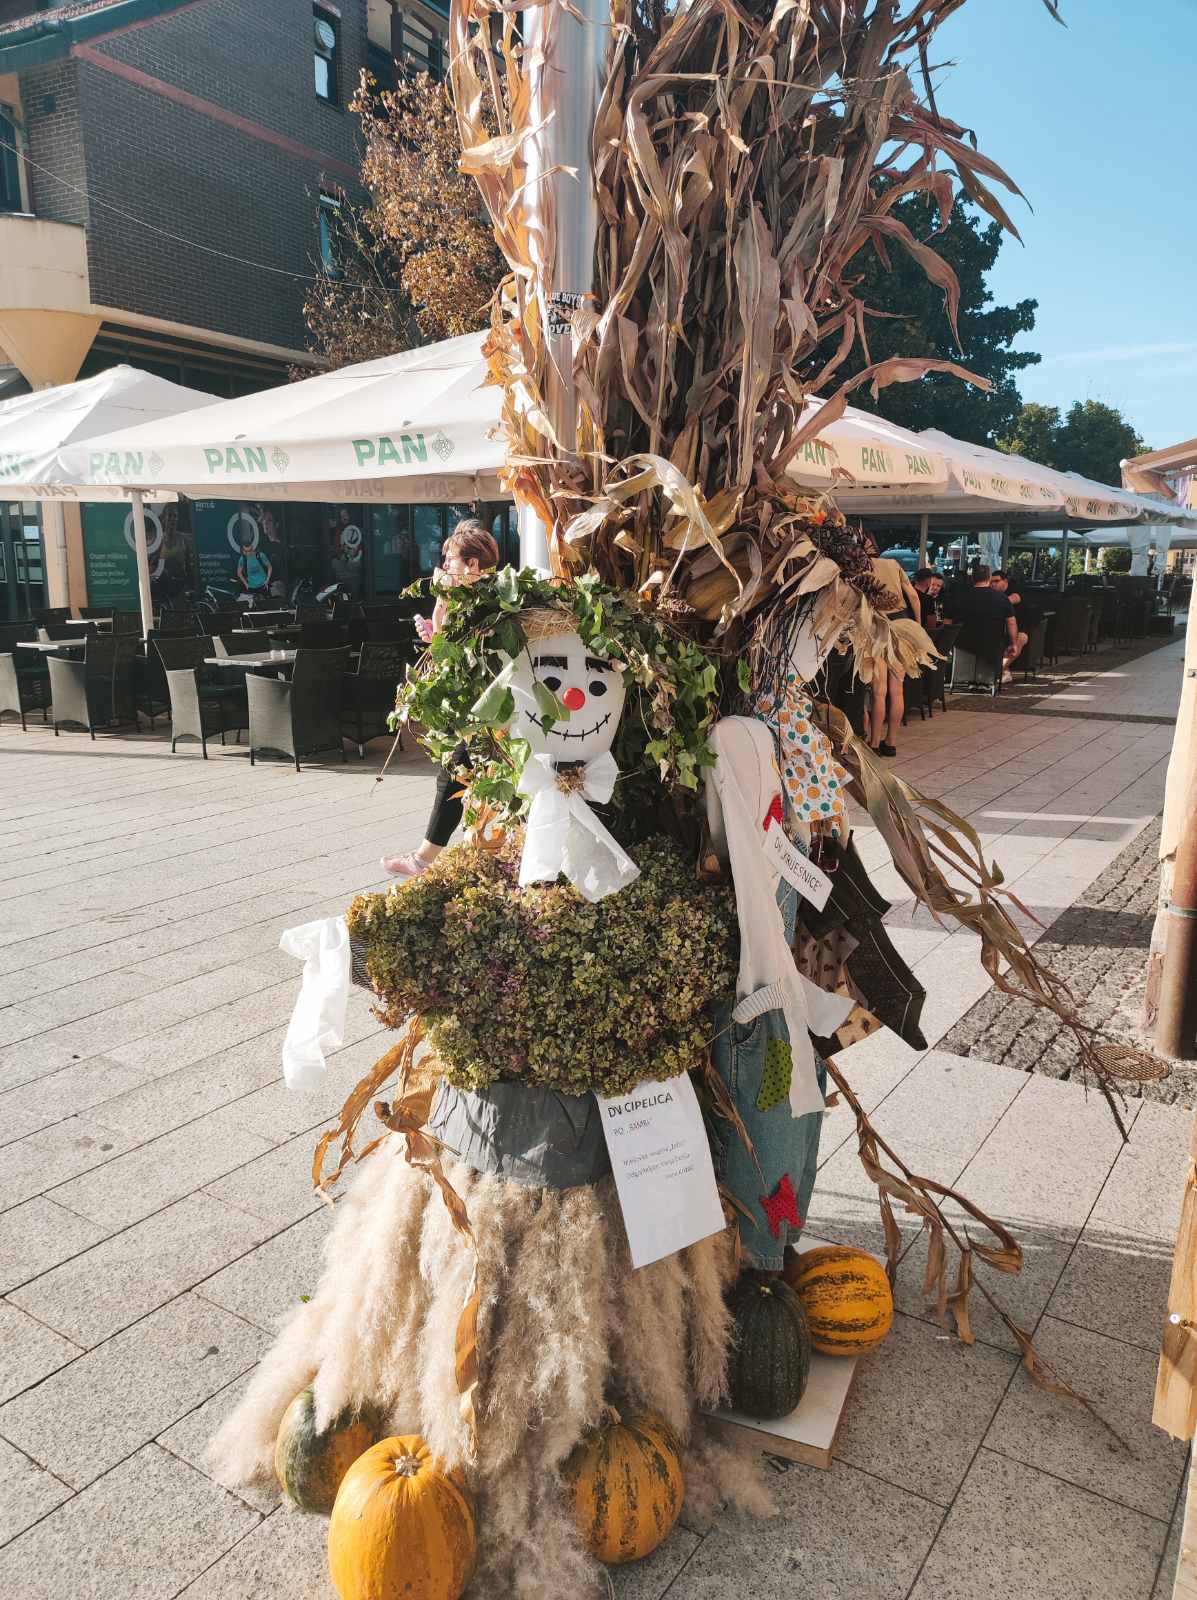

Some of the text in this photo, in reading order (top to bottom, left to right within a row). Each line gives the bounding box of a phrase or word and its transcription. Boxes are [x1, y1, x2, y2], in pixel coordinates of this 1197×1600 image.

[89, 450, 144, 476] PAN
[203, 446, 268, 474] PAN
[351, 433, 429, 467] PAN
[862, 446, 887, 472] PAN
[905, 454, 932, 476] PAN
[607, 1092, 674, 1118] DV CIPELICA
